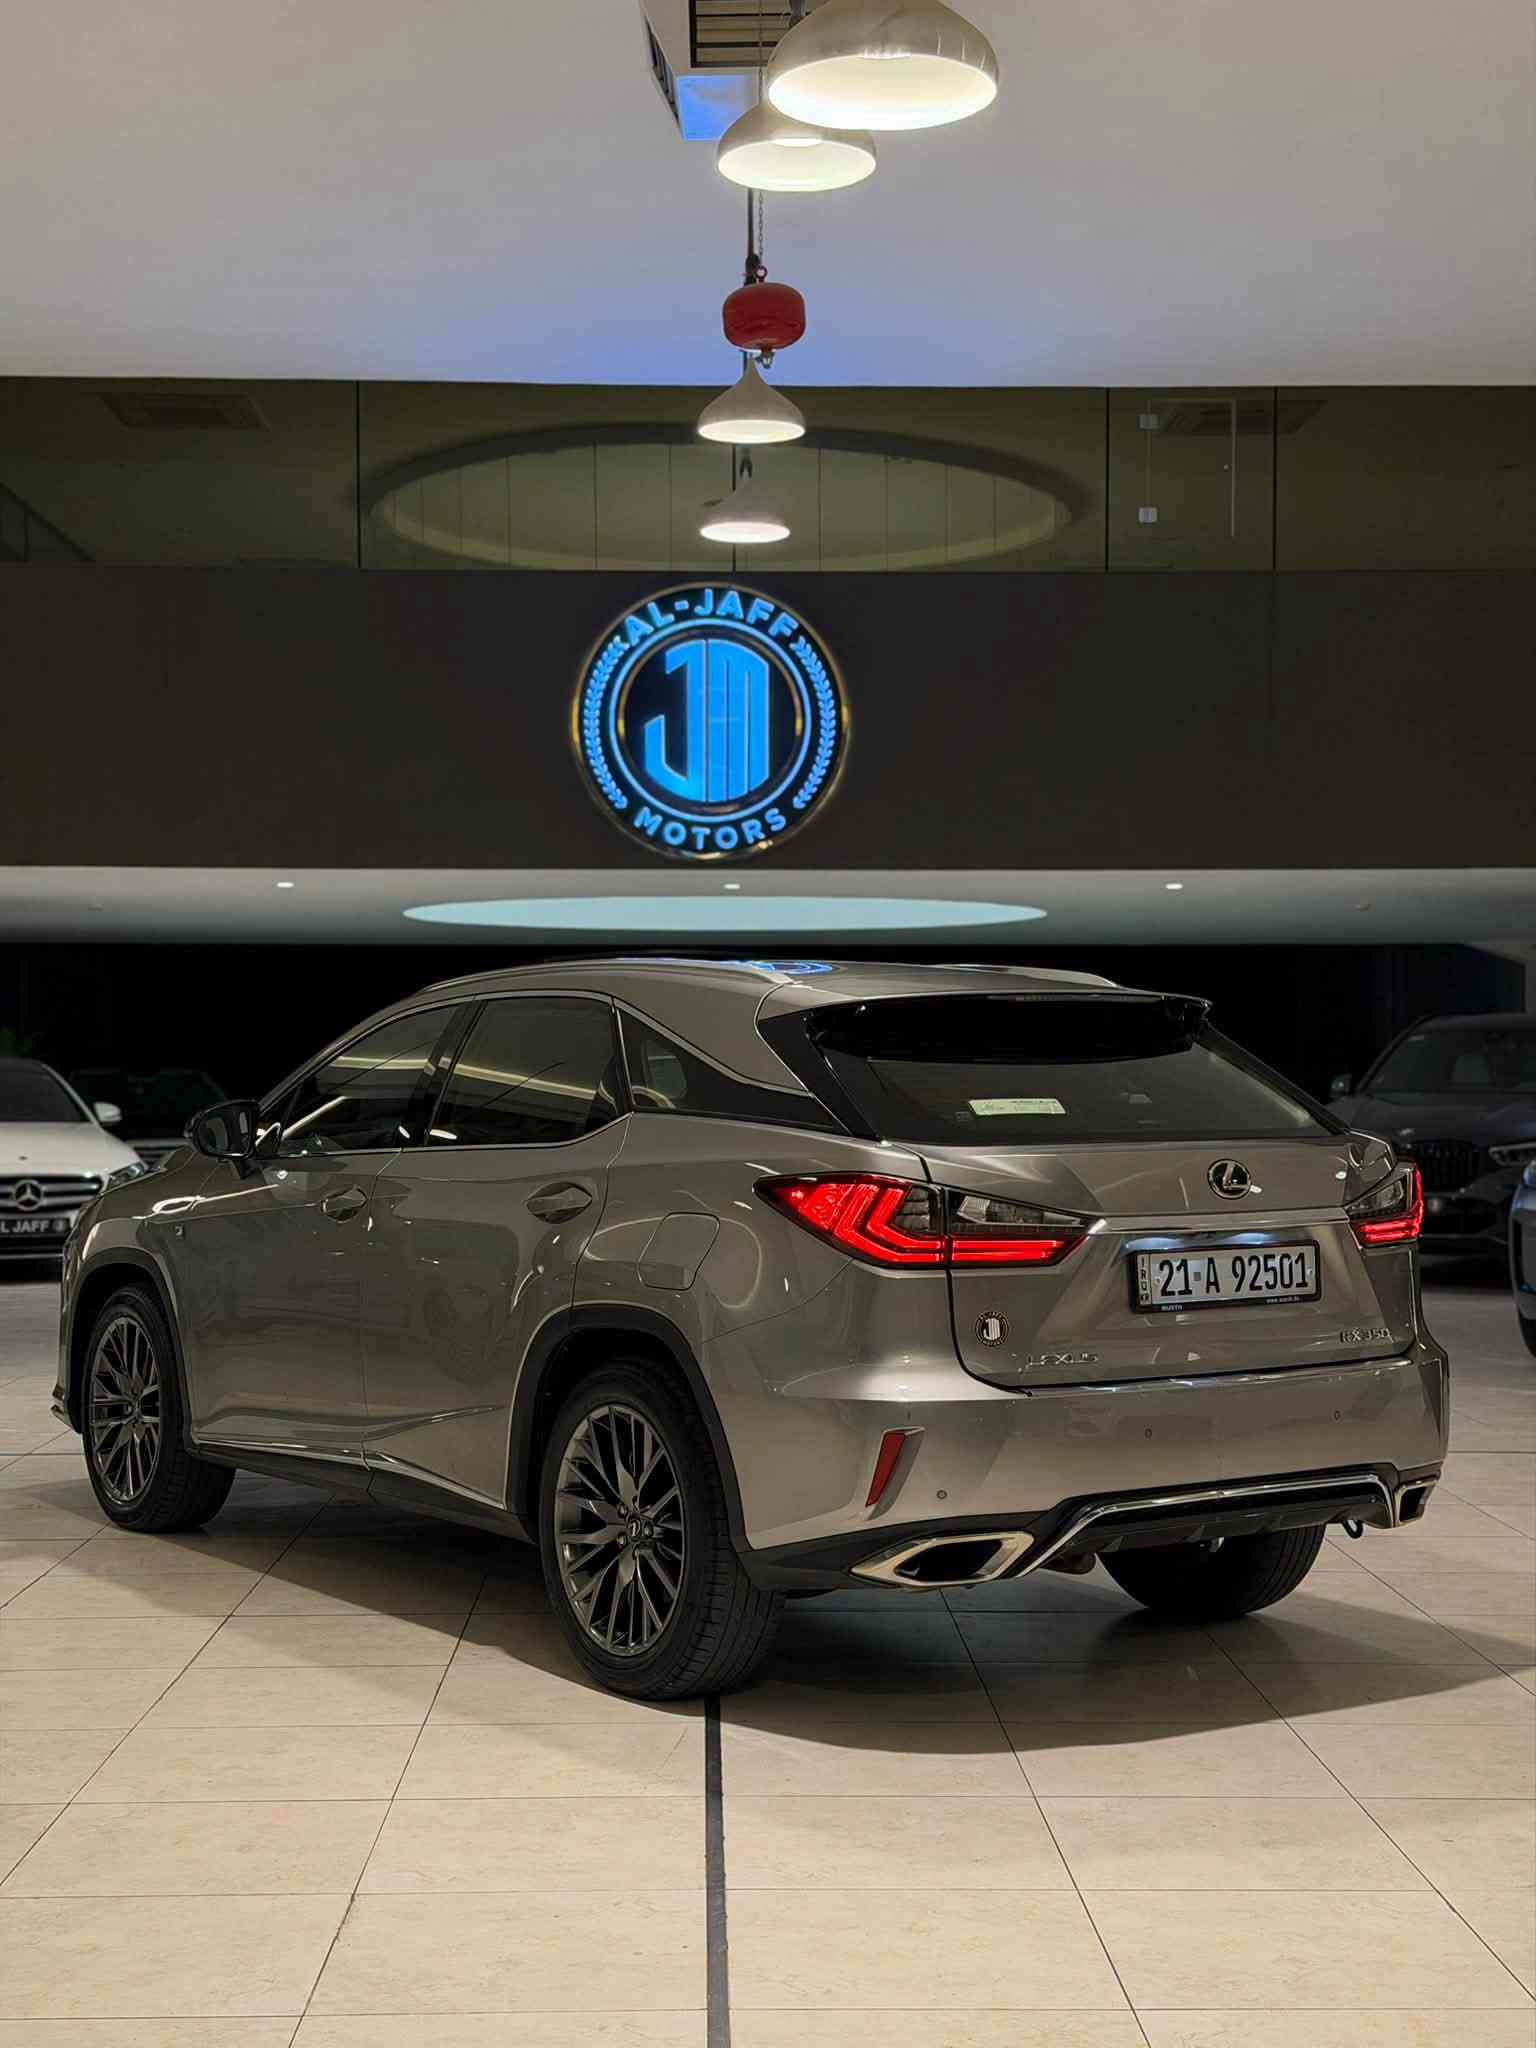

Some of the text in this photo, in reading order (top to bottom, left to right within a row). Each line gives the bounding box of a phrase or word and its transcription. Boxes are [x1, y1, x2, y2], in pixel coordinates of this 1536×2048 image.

[624, 588, 799, 645] AL-JAFF
[634, 807, 787, 850] MOTORS
[12, 1220, 49, 1233] JAFF
[1159, 1252, 1309, 1297] 21 A 92501
